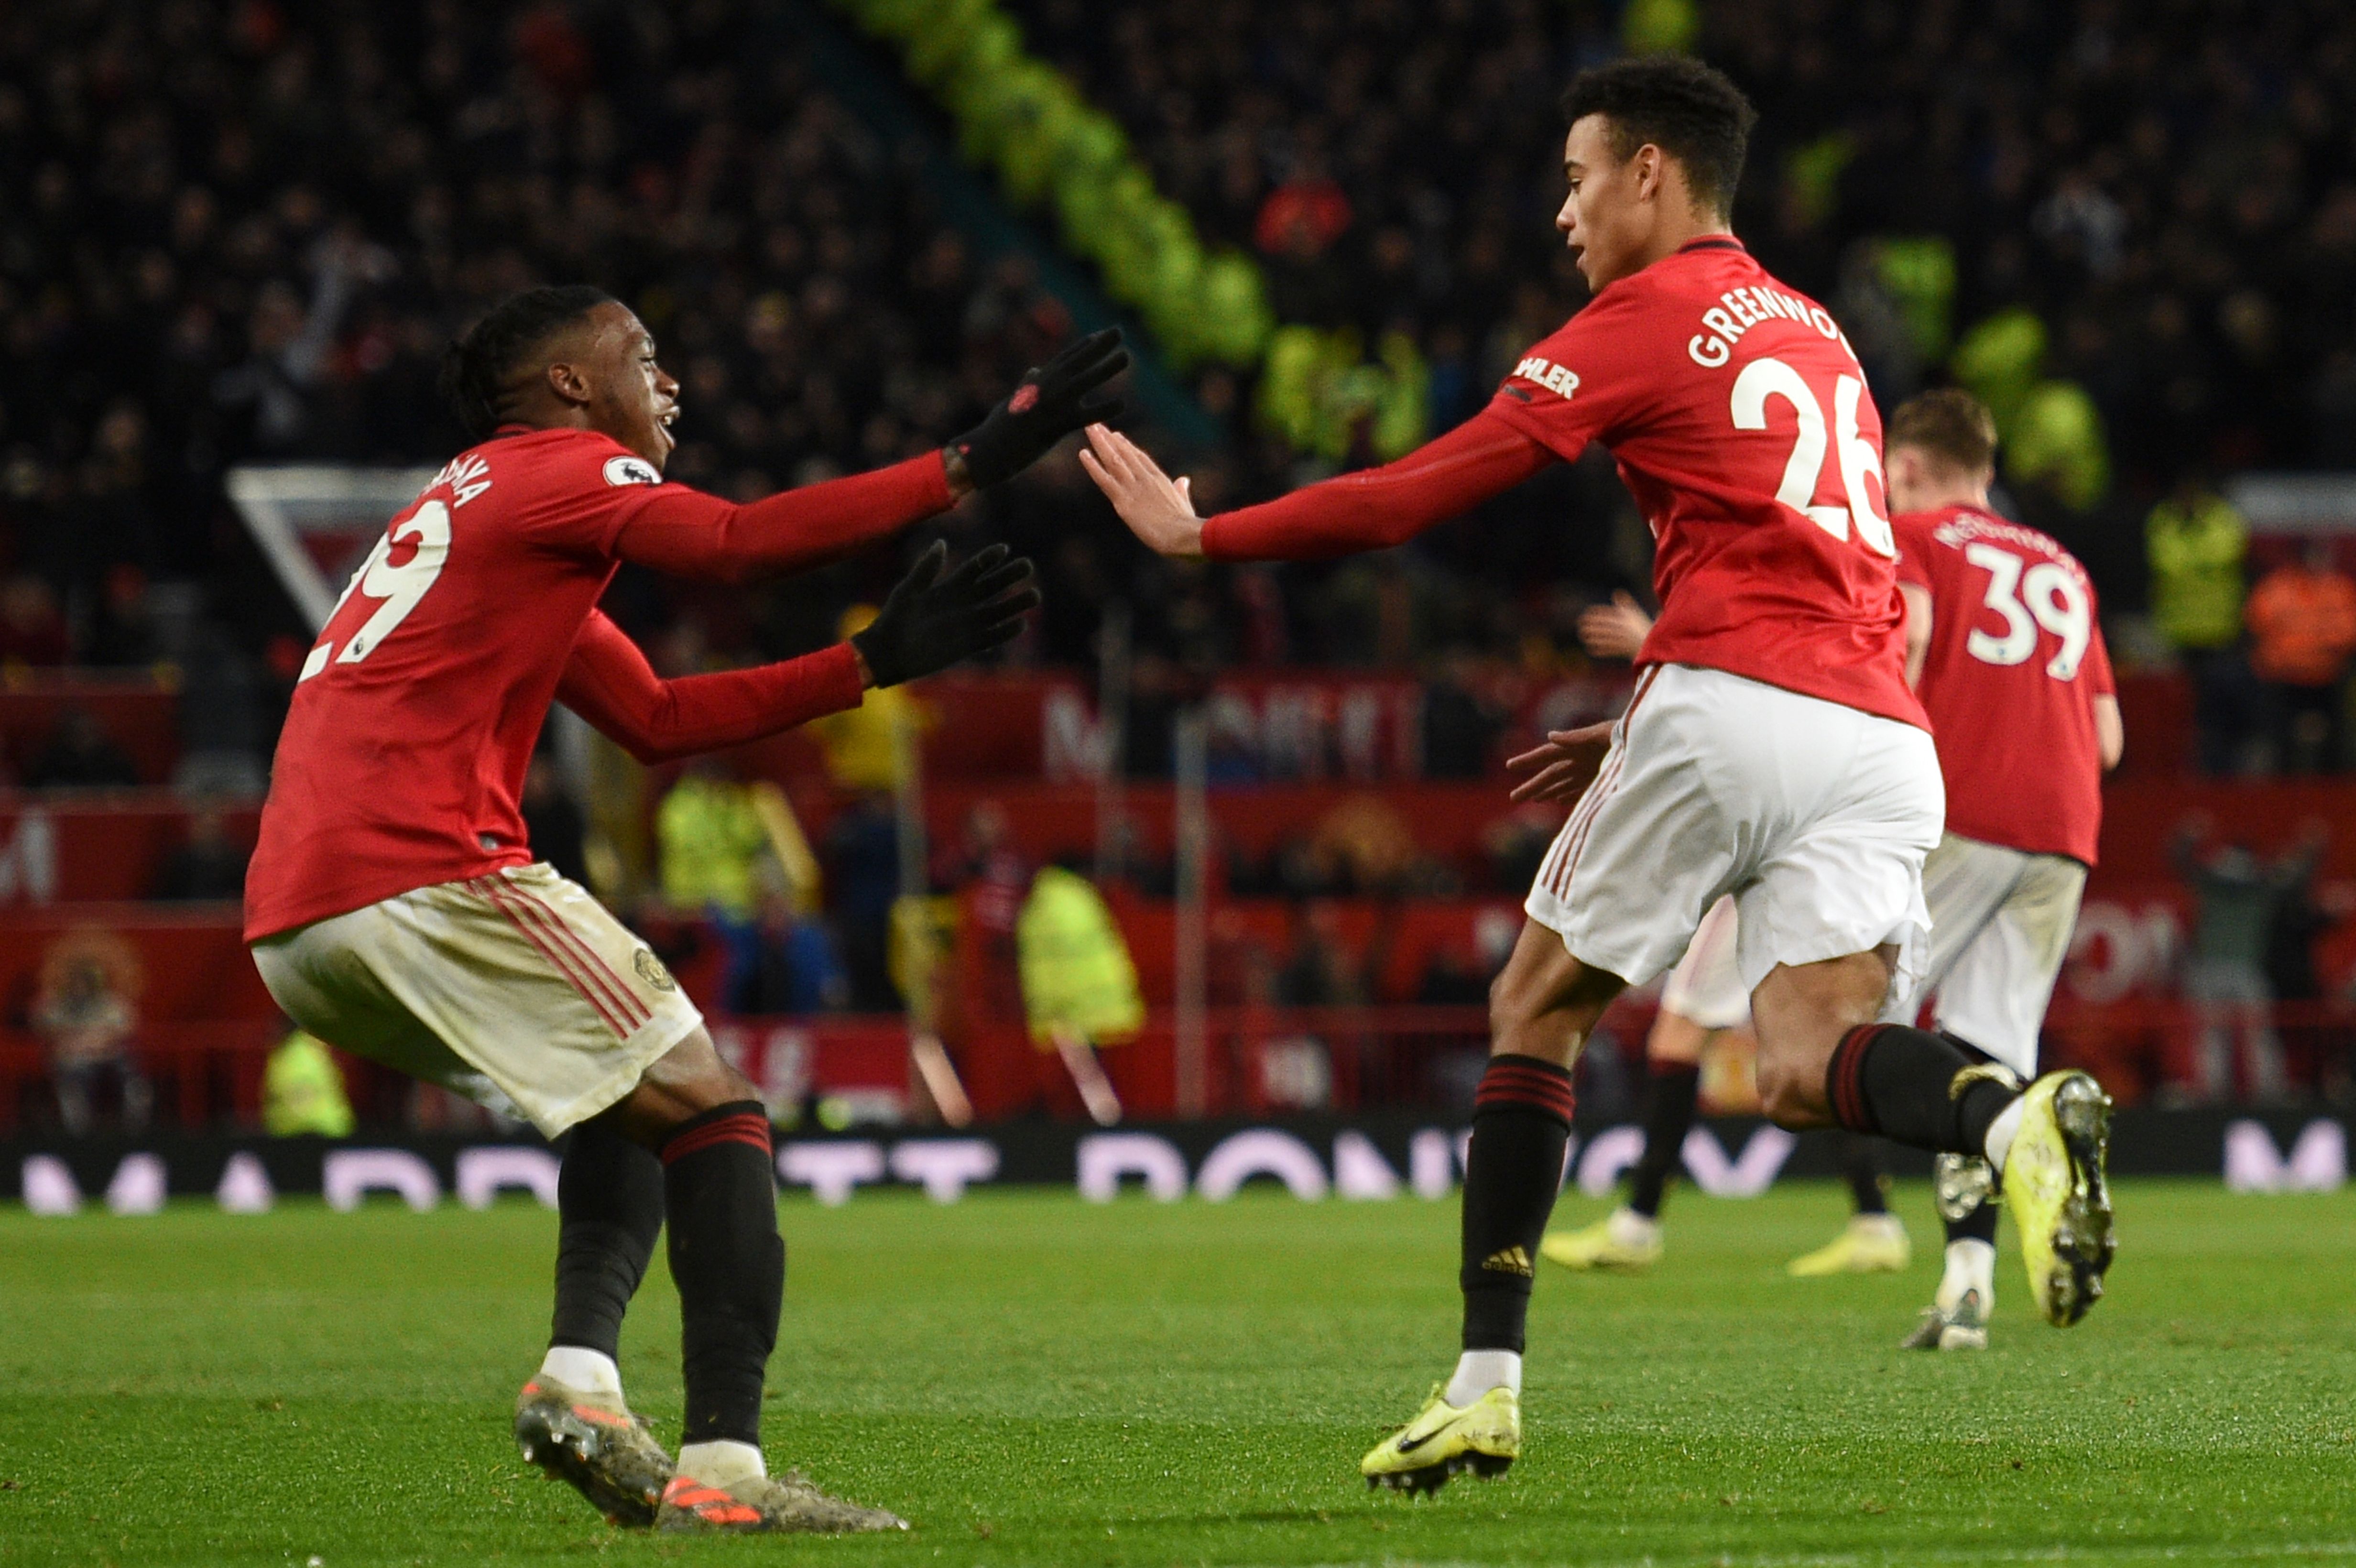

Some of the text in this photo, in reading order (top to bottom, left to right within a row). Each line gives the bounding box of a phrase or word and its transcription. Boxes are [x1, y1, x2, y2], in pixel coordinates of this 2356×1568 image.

[1689, 287, 1868, 390] GREENWO
[1730, 357, 1897, 558] 26
[1965, 541, 2091, 682] 39
